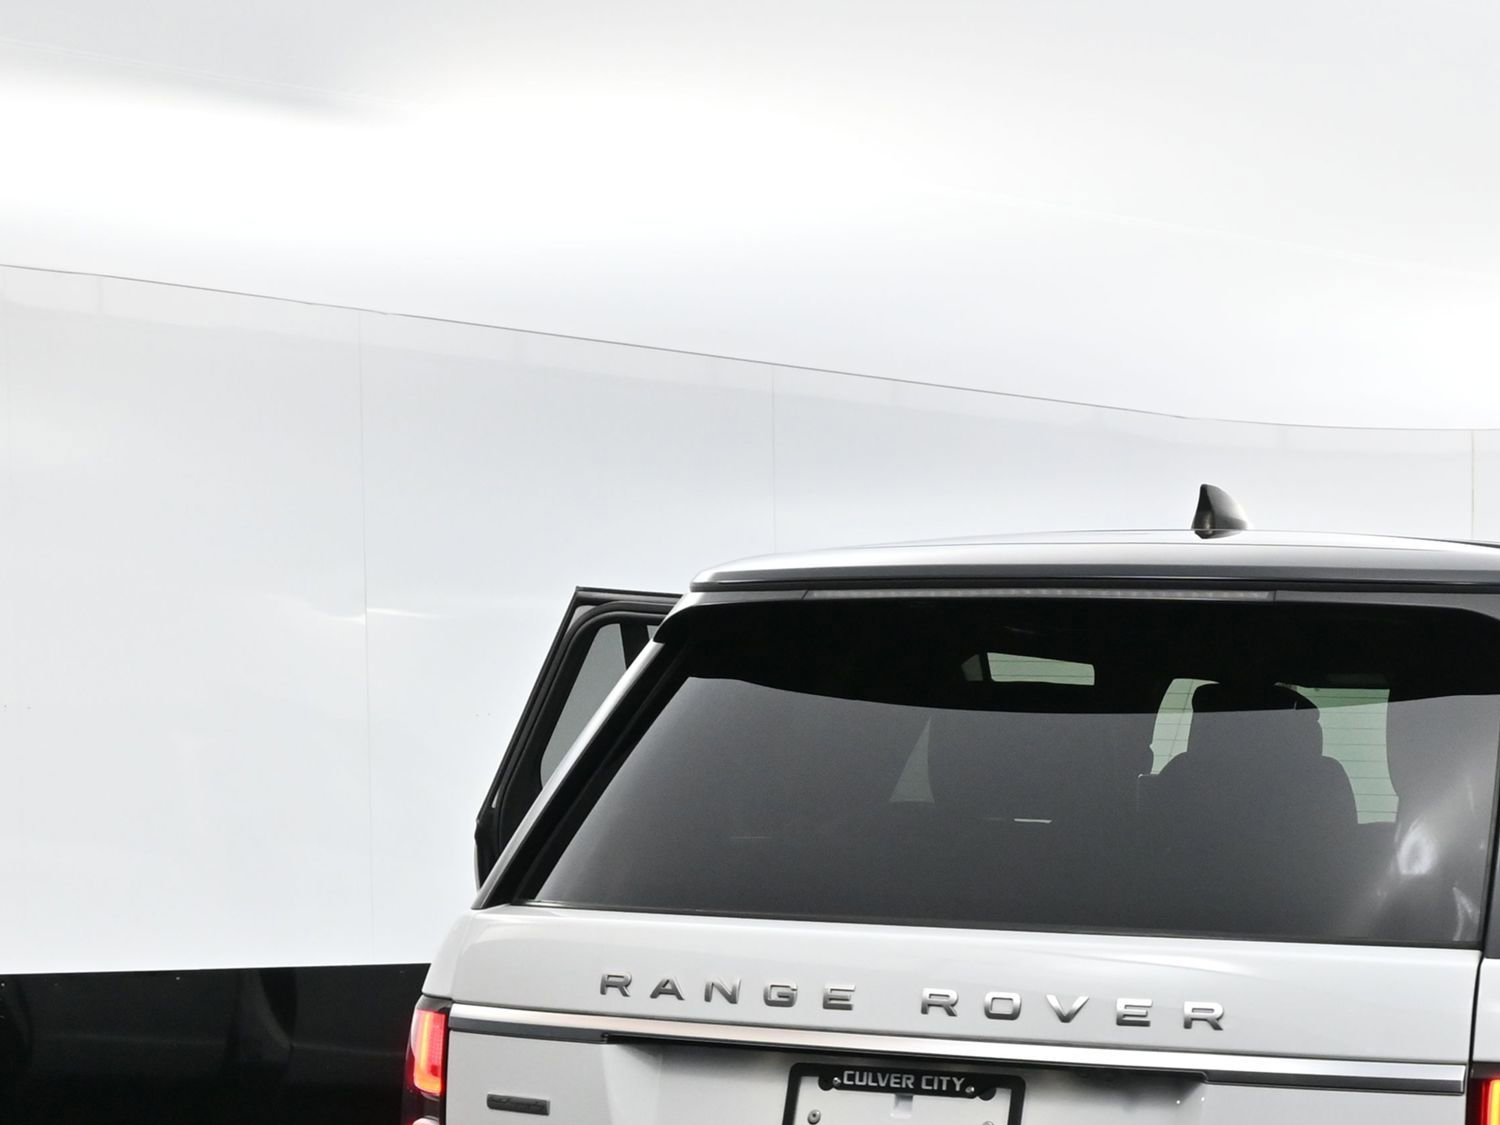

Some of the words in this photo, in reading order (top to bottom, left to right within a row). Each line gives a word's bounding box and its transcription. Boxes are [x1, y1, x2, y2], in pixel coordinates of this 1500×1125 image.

[600, 972, 856, 1011] RANGE
[920, 987, 1225, 1031] ROVER
[843, 1070, 914, 1089] CULVER
[921, 1075, 966, 1092] CITY
